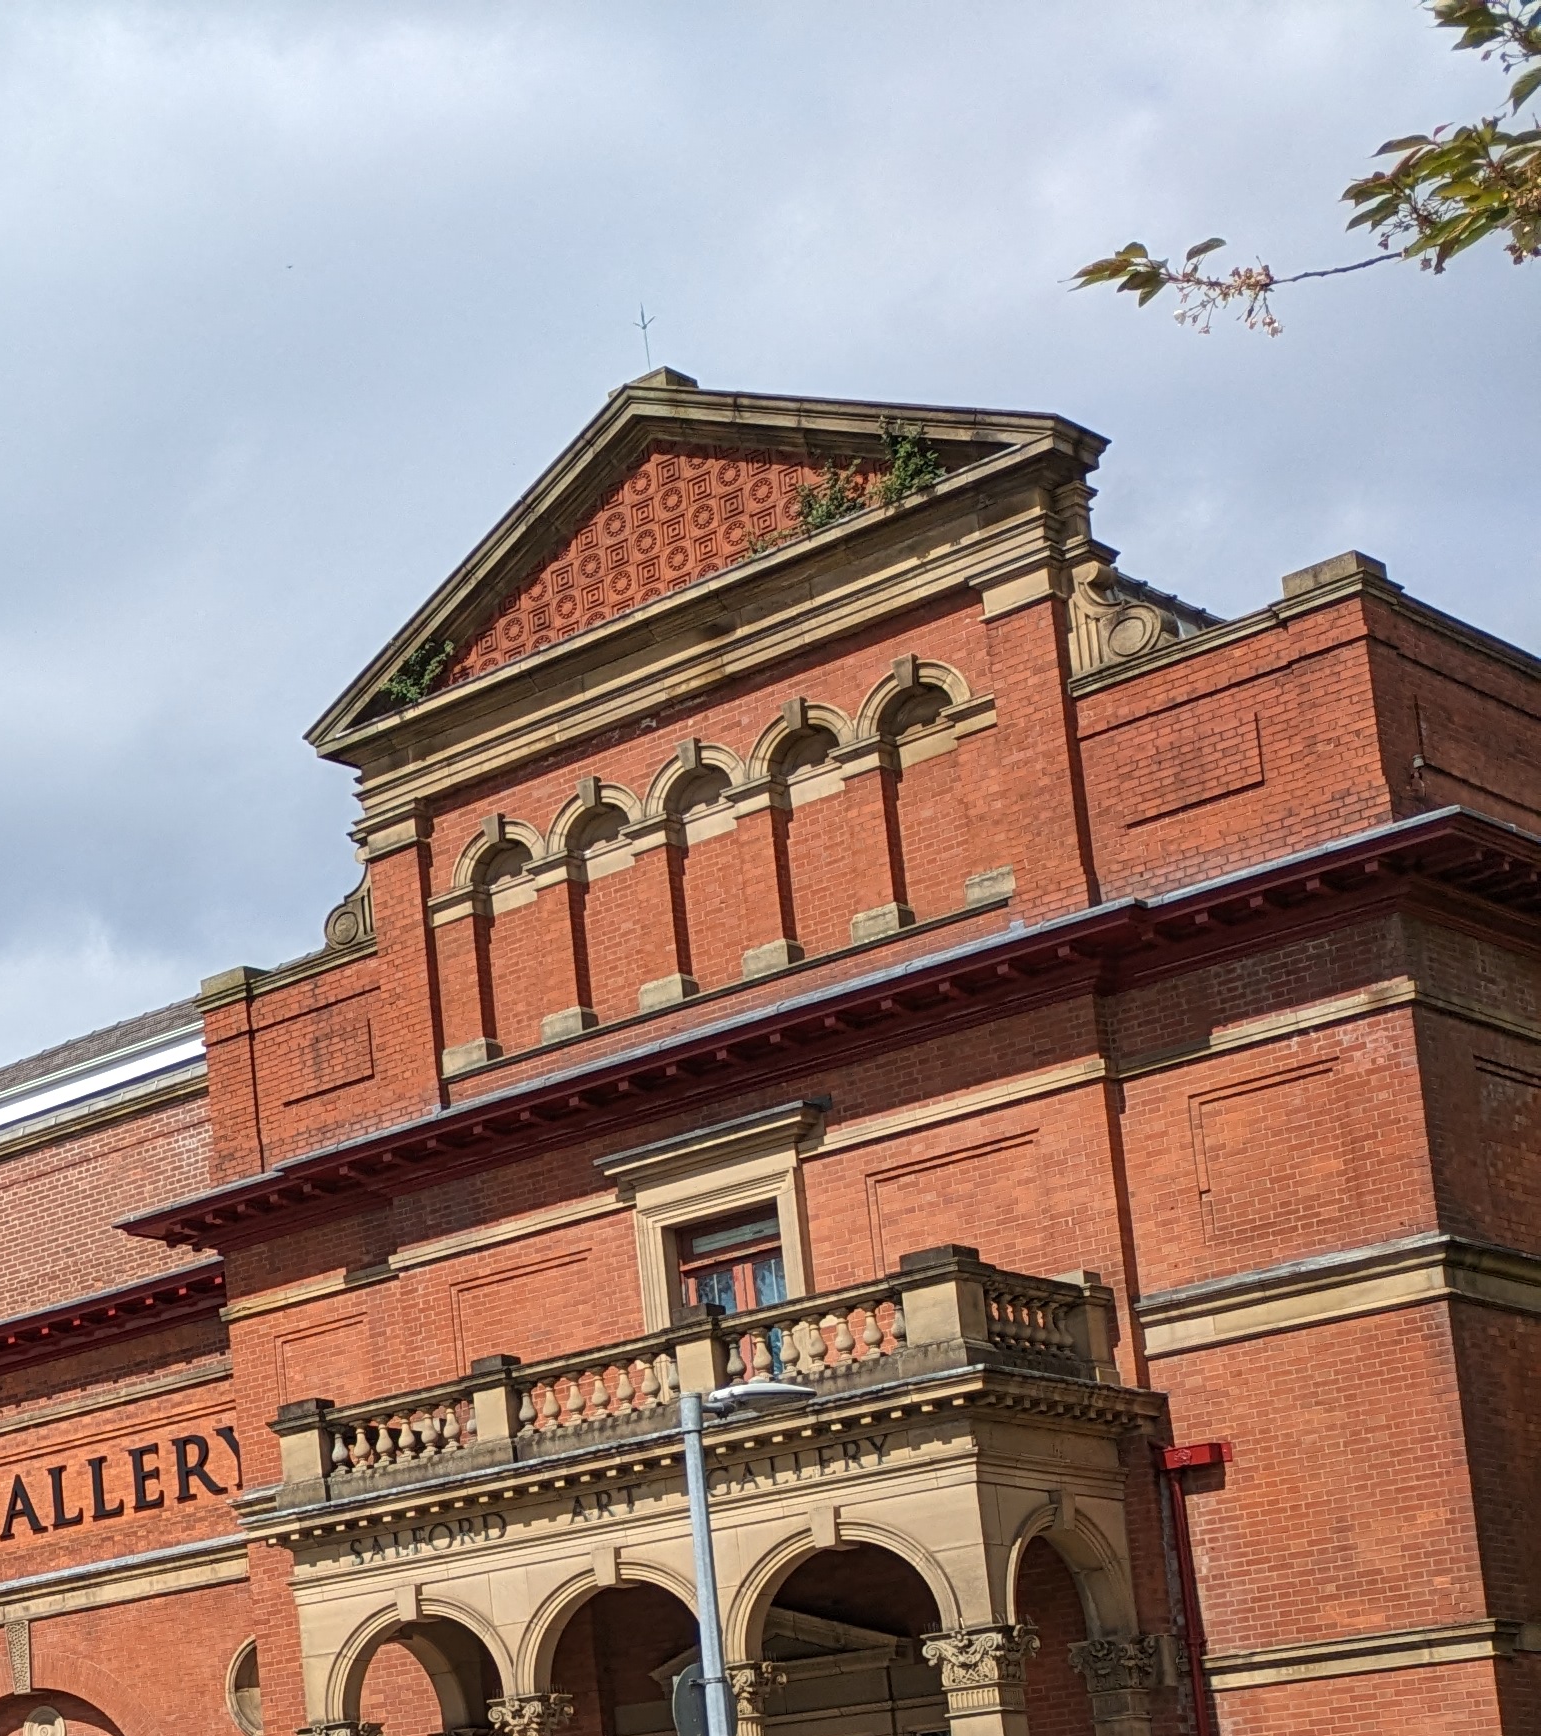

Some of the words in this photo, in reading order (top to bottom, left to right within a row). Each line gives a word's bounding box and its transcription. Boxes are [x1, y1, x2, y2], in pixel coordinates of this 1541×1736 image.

[348, 1512, 508, 1567] SALFORD
[569, 1484, 639, 1525] ART
[706, 1433, 889, 1498] GALLERY
